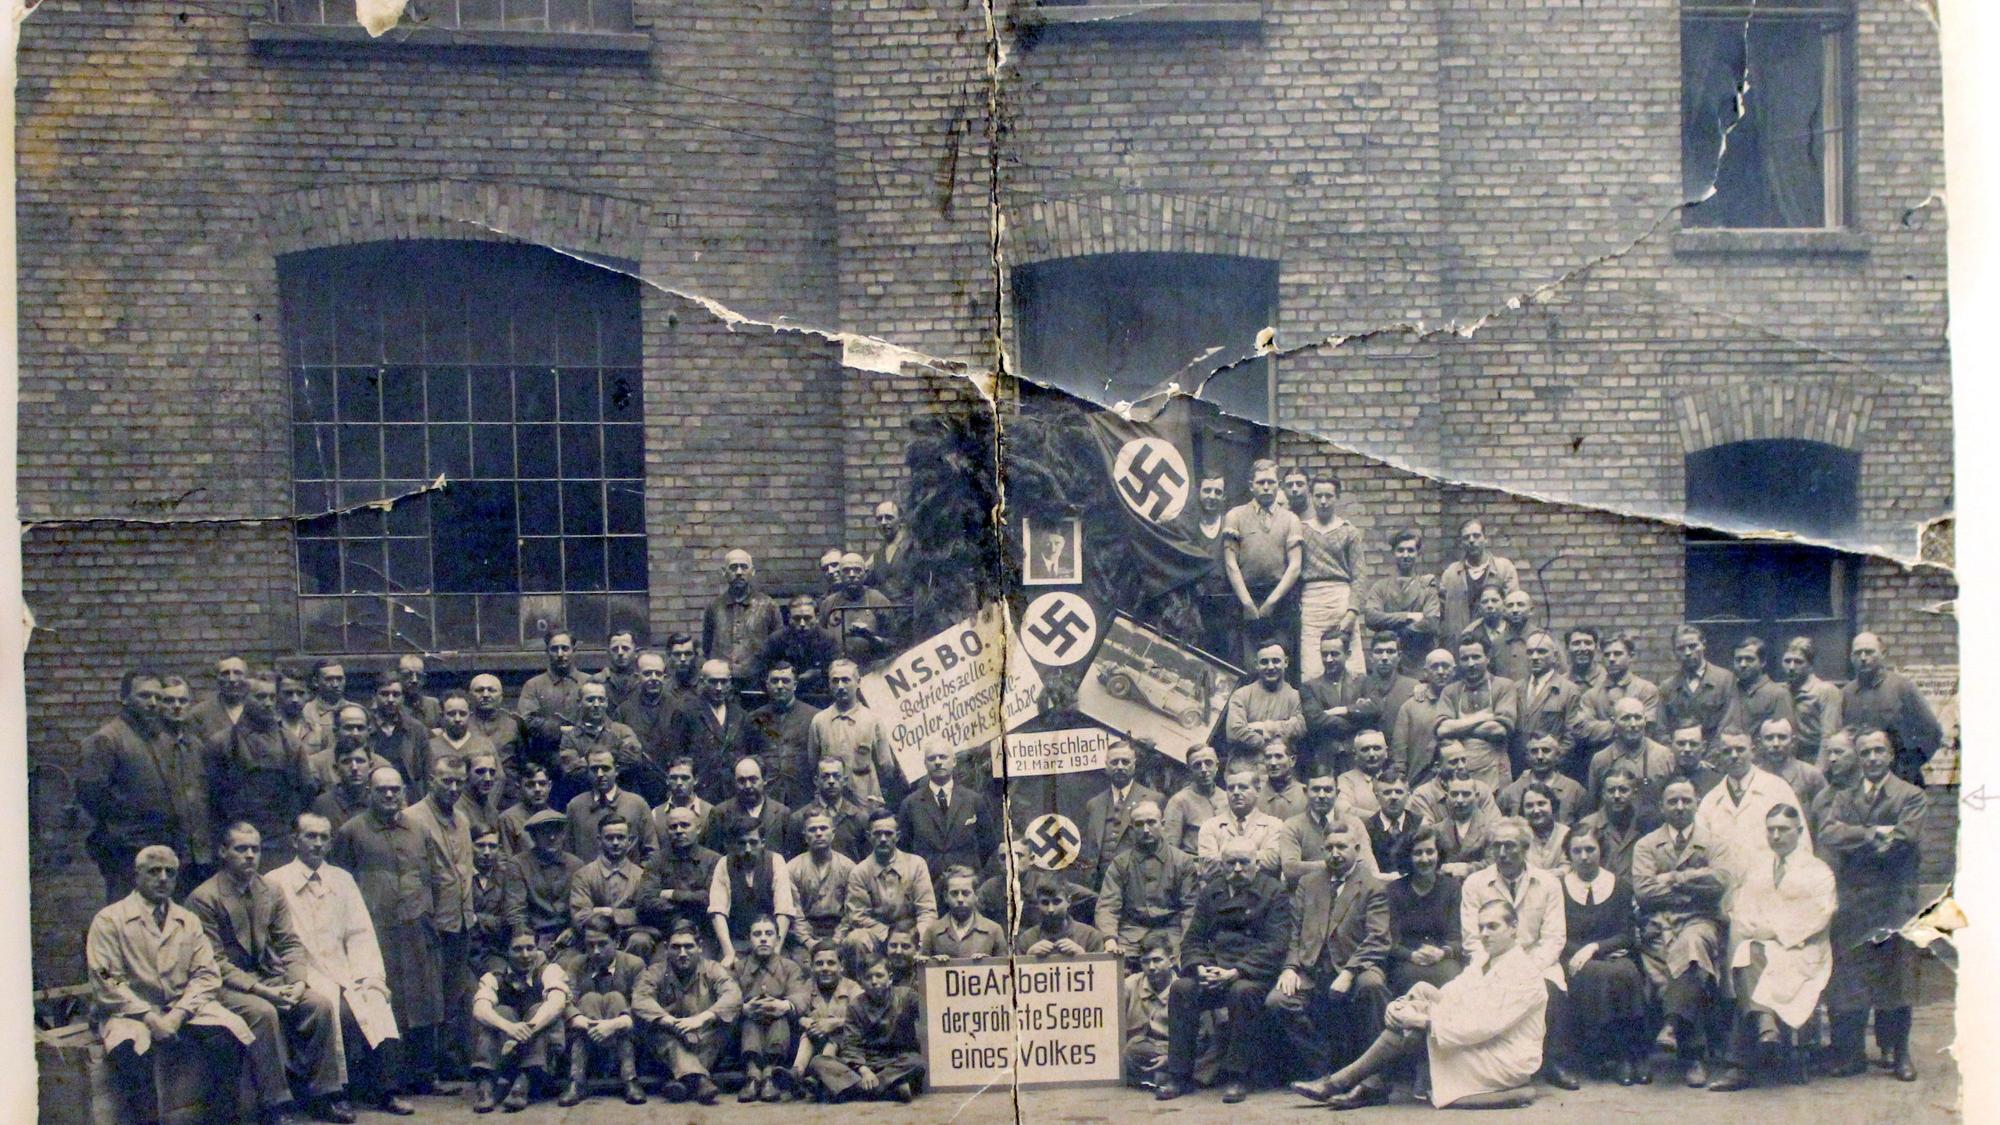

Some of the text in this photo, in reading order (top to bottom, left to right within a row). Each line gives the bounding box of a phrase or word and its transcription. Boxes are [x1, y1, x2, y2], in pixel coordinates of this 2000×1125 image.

[884, 629, 991, 700] N.S.B.O.
[942, 711, 989, 747] Werk
[1071, 754, 1097, 767] 1934
[946, 964, 1094, 997] Die Arbeit ist
[942, 1007, 969, 1034] der
[1047, 1003, 1103, 1030] Segen
[951, 1039, 1096, 1069] eines Volkes
